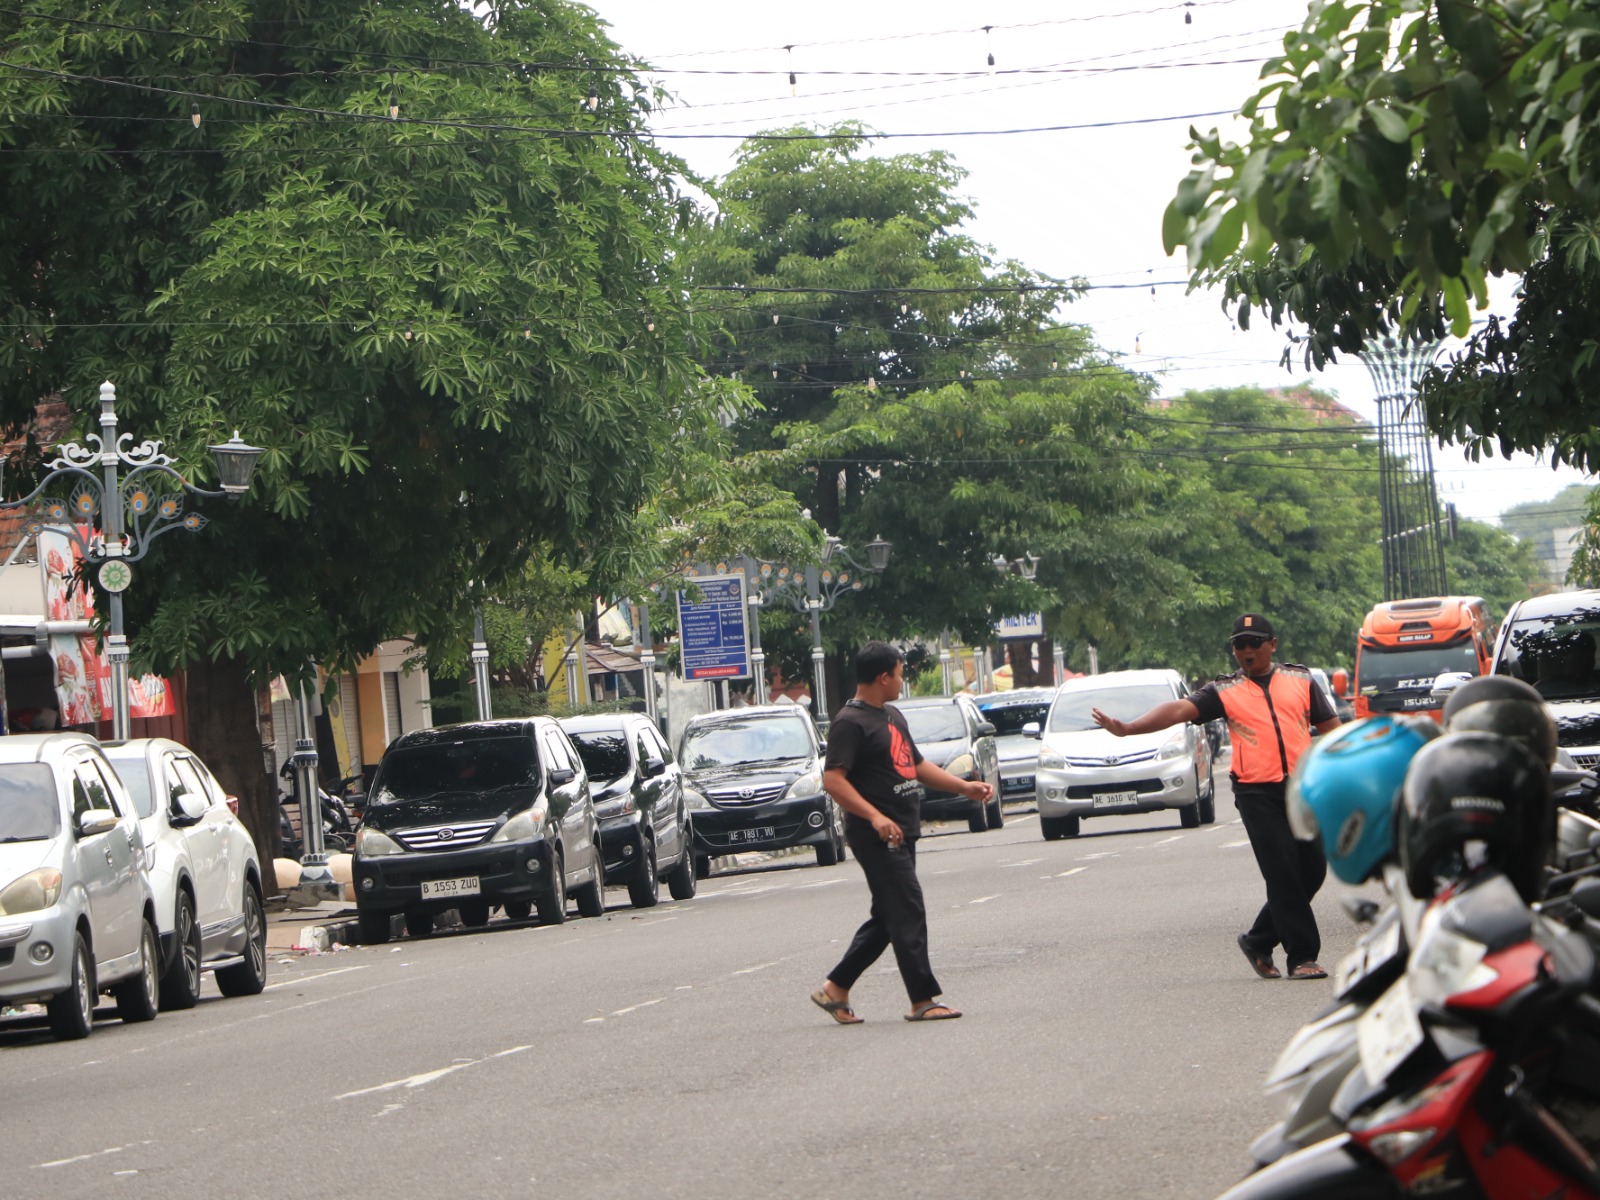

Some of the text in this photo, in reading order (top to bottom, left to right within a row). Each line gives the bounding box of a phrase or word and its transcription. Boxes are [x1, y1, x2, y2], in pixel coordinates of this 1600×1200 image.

[1404, 697, 1436, 707] ISUZU
[423, 883, 430, 893] B
[434, 880, 457, 892] 1553
